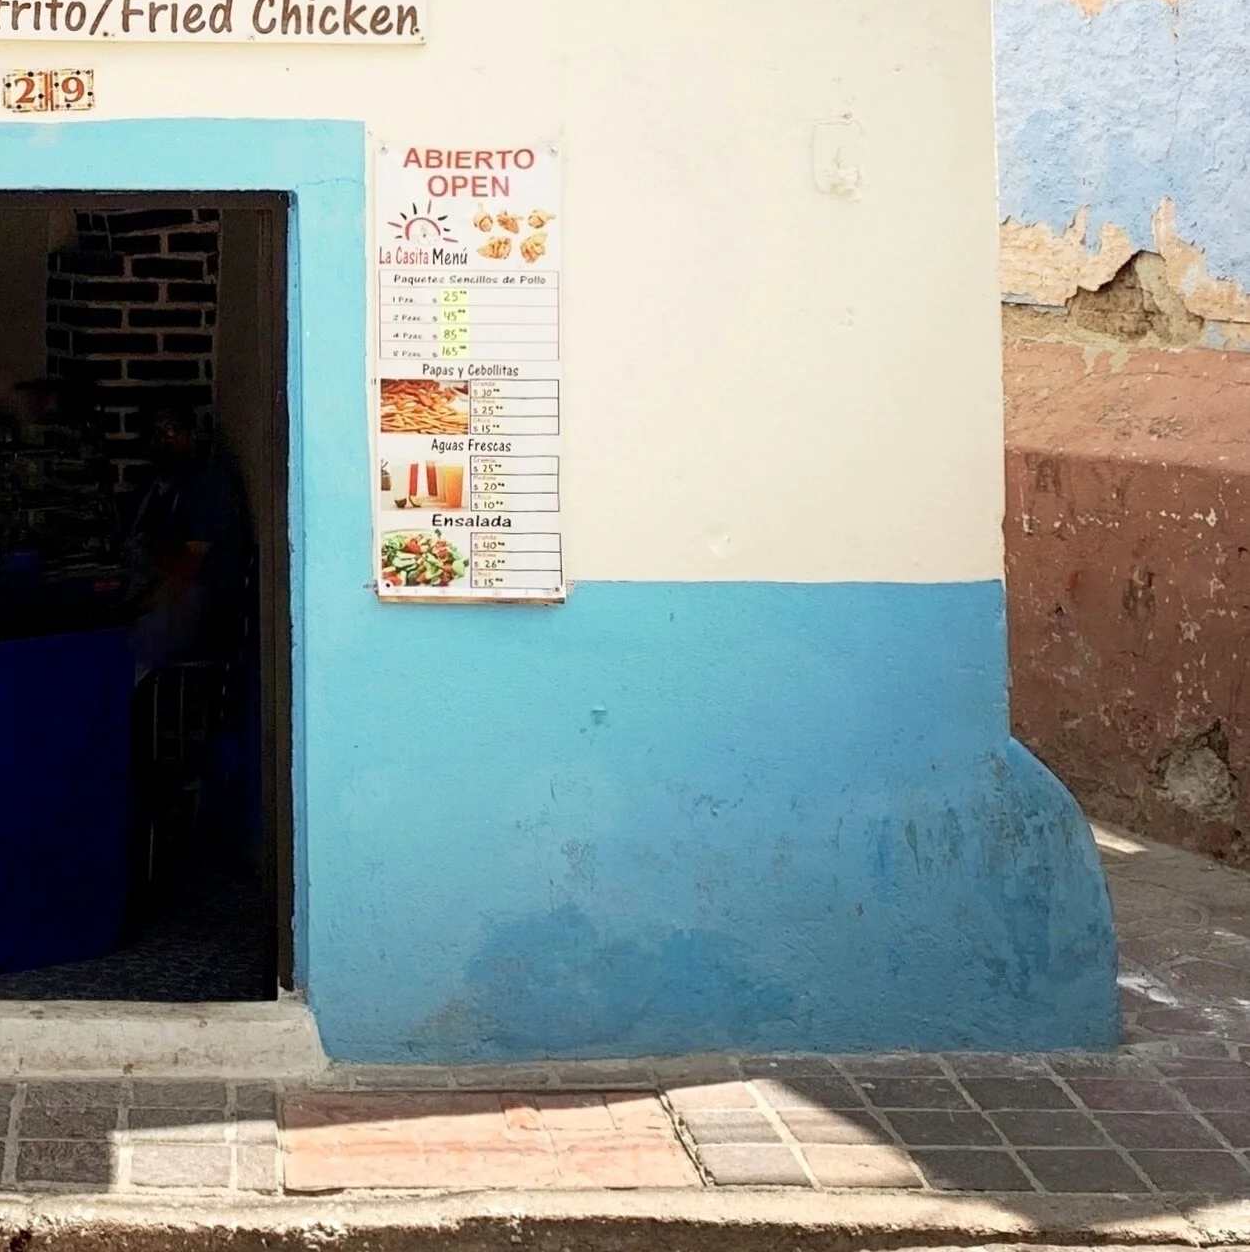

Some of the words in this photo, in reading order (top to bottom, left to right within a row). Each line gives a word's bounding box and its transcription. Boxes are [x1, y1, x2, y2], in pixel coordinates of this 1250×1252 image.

[13, 76, 86, 104] 29
[403, 147, 535, 170] ABIERTO
[427, 175, 509, 198] OPEN
[379, 246, 392, 265] La
[395, 246, 430, 265] Casita
[432, 247, 469, 265] Menú
[393, 274, 445, 286] Paquetes
[449, 275, 499, 285] Sencillos
[502, 275, 515, 285] de
[519, 275, 547, 285] Pollo
[422, 363, 454, 377] Papas
[457, 366, 464, 379] y
[467, 363, 519, 377] Cebollitas
[431, 437, 464, 454] Aguas
[468, 438, 512, 452] Frescas
[431, 513, 512, 527] Ensalada
